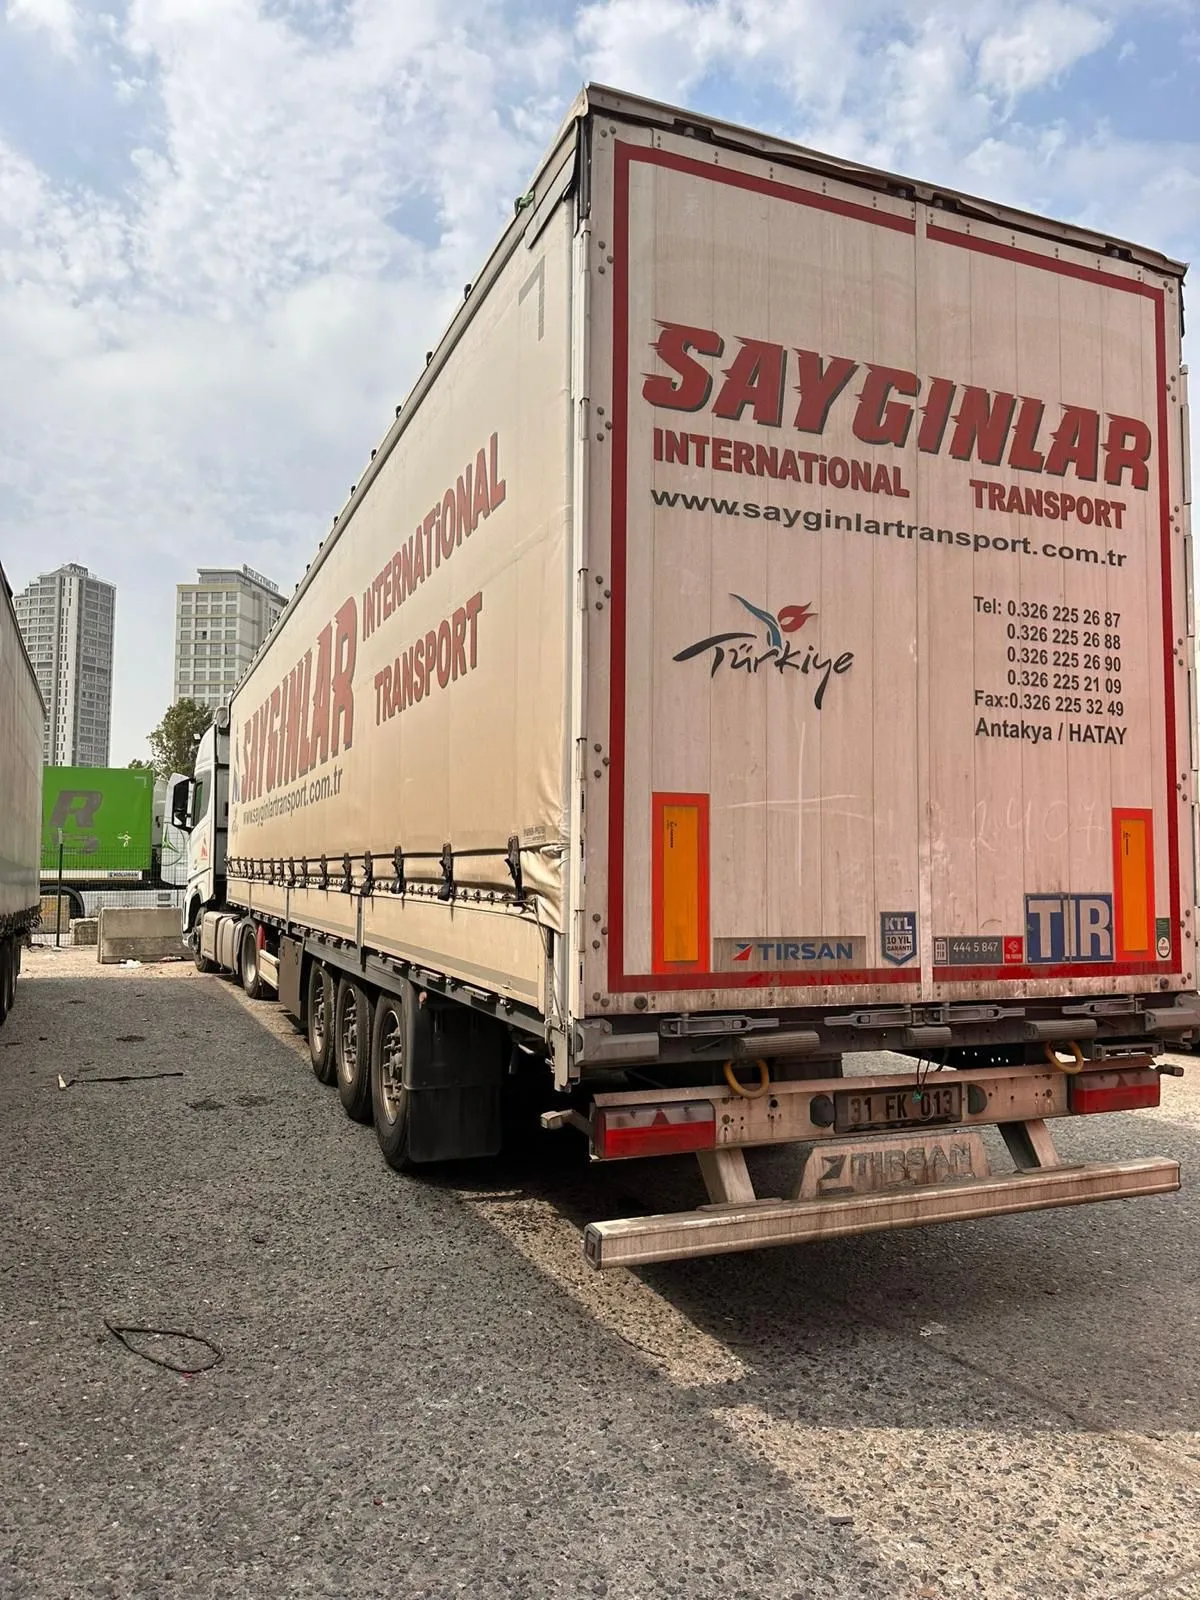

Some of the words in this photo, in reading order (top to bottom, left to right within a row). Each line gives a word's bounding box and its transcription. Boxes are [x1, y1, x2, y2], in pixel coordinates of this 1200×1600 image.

[642, 319, 1152, 490] SAYGINLAR
[969, 478, 1126, 530] TRANSPORT
[650, 489, 1128, 568] www.sayginlartransport.com.tr
[973, 596, 1002, 615] Tel:
[1007, 600, 1048, 620] 0.326
[1052, 606, 1079, 623] 225
[1083, 609, 1100, 626] 26
[1104, 612, 1121, 628] 87
[1007, 623, 1048, 642] 0.326
[1052, 628, 1079, 645] 225
[1083, 631, 1100, 648] 26
[1104, 634, 1121, 650] 88
[374, 591, 483, 727] TRANSPORT
[672, 632, 855, 710] Türkiye
[1007, 646, 1048, 665] 0.326
[1052, 651, 1079, 668] 225
[1083, 654, 1100, 670] 26
[1104, 656, 1121, 672] 90
[1007, 669, 1049, 688] 0.326
[1053, 673, 1080, 690] 225
[1084, 676, 1100, 692] 21
[1105, 678, 1122, 694] 09
[241, 596, 358, 805] SAYGINLAR
[1055, 696, 1082, 713] 225
[1086, 698, 1103, 714] 32
[1107, 700, 1124, 717] 49
[975, 717, 1052, 744] Antakya
[1069, 723, 1127, 745] HATAY
[884, 917, 912, 930] KTL
[1028, 899, 1112, 958] TIR
[757, 943, 853, 961] TIRSAN
[887, 936, 897, 945] 10
[953, 942, 971, 953] 444
[973, 942, 980, 952] 5
[981, 941, 999, 952] 847
[851, 1097, 872, 1123] 31
[886, 1093, 908, 1121] FK
[920, 1090, 953, 1116] 013
